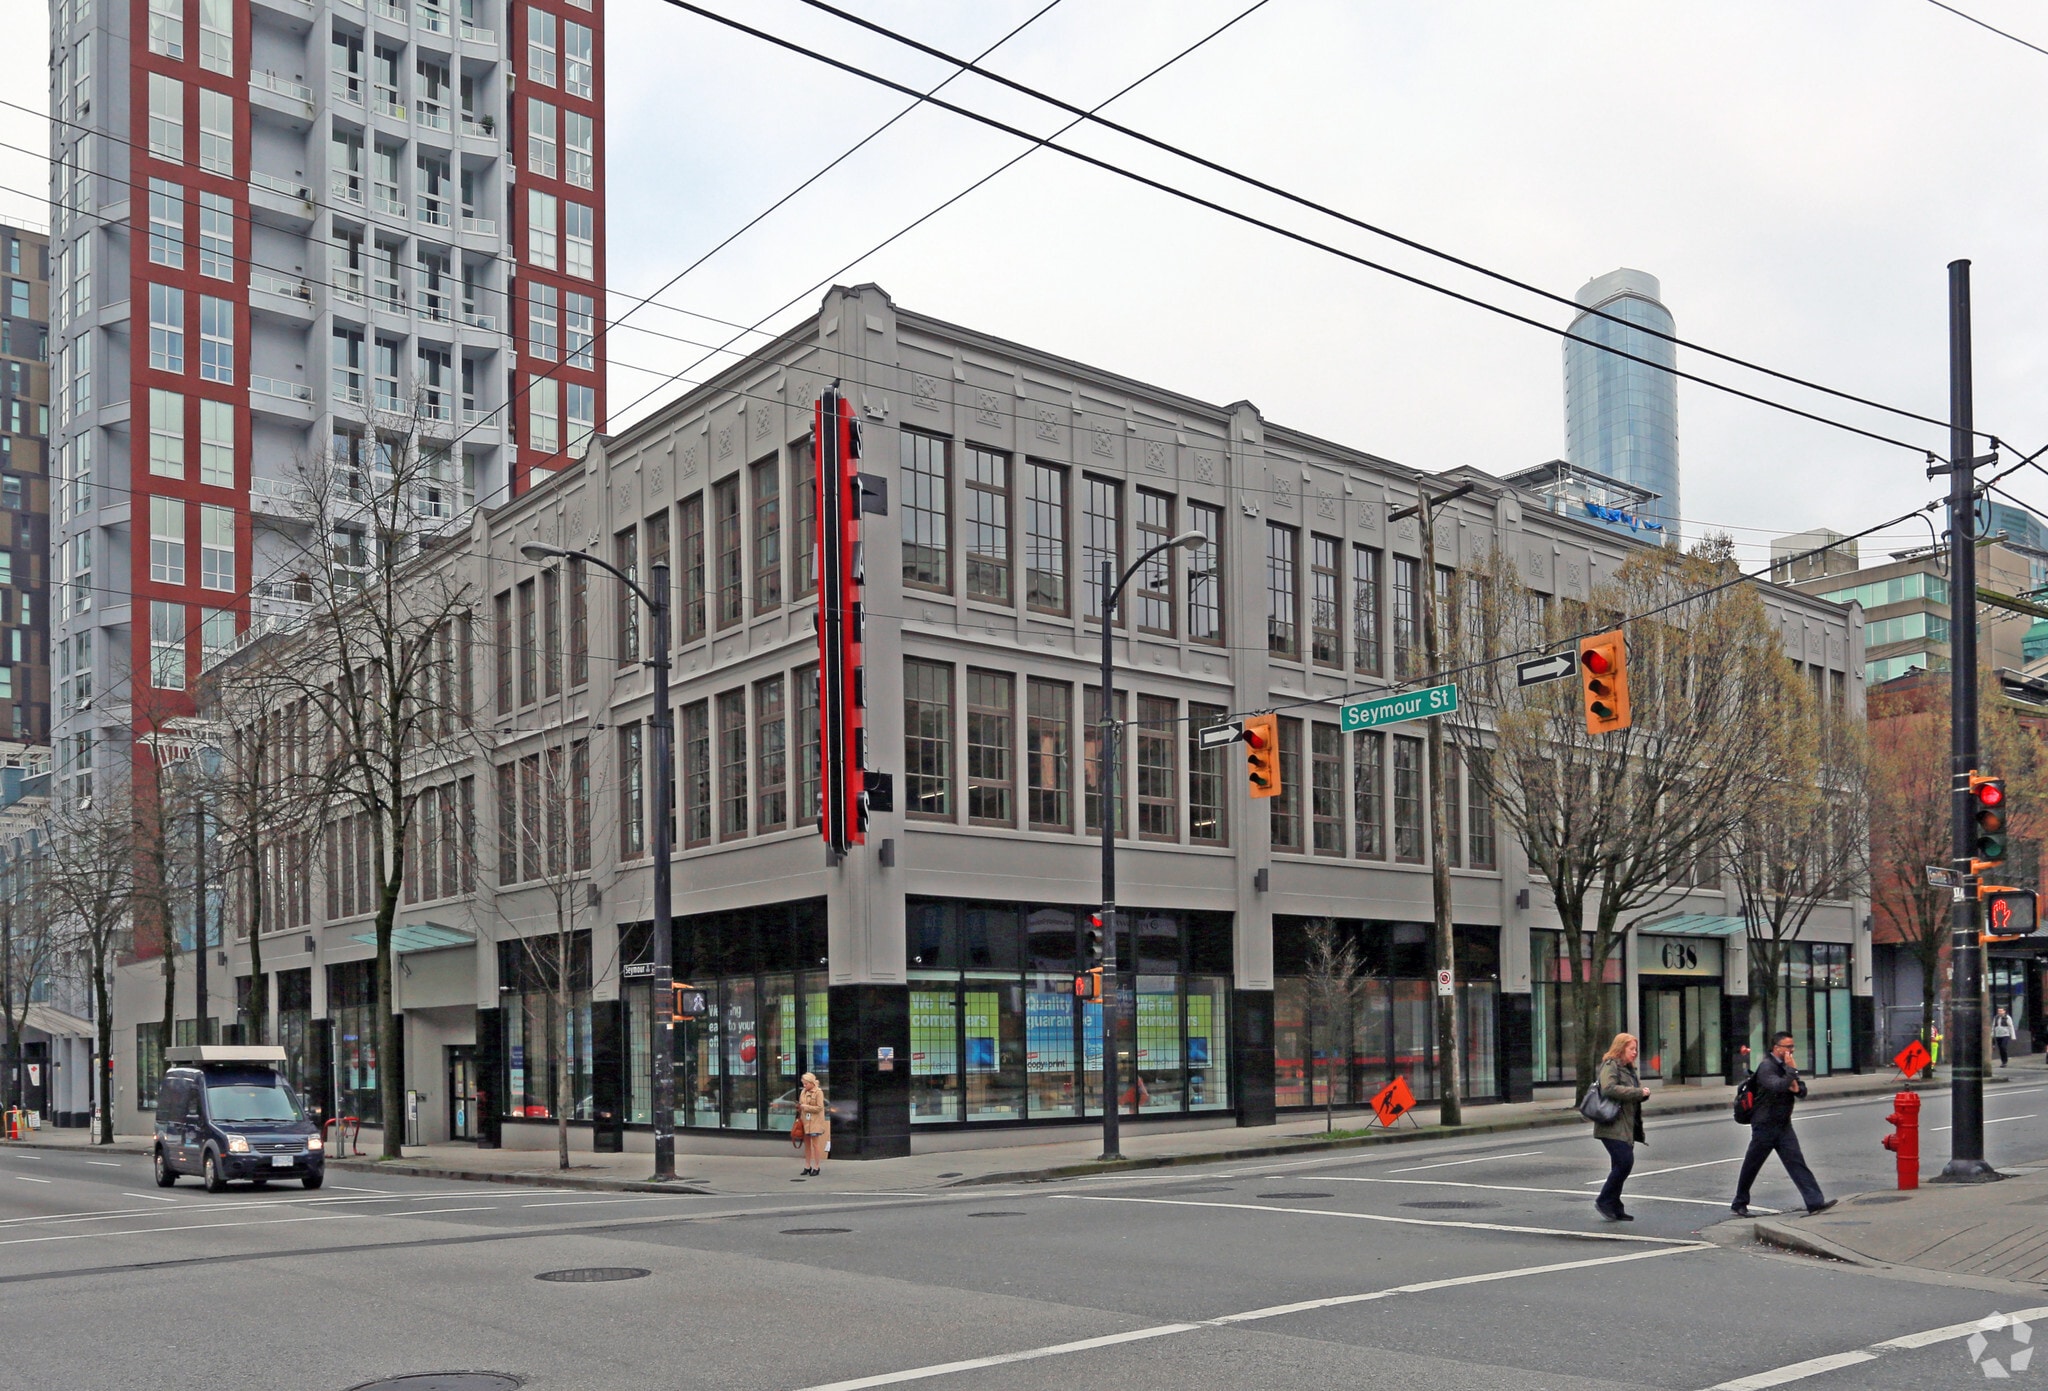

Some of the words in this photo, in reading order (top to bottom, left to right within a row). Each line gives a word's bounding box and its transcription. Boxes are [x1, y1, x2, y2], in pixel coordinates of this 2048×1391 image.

[1348, 698, 1422, 725] Seymour
[1430, 689, 1449, 709] St
[1662, 944, 1697, 969] 638
[625, 966, 645, 976] Seymour
[911, 993, 933, 1009] We
[1026, 995, 1071, 1013] Quality
[1137, 996, 1155, 1010] We
[1158, 996, 1172, 1011] fix
[728, 1020, 736, 1031] to
[738, 1020, 756, 1034] your
[912, 1014, 988, 1030] compuers
